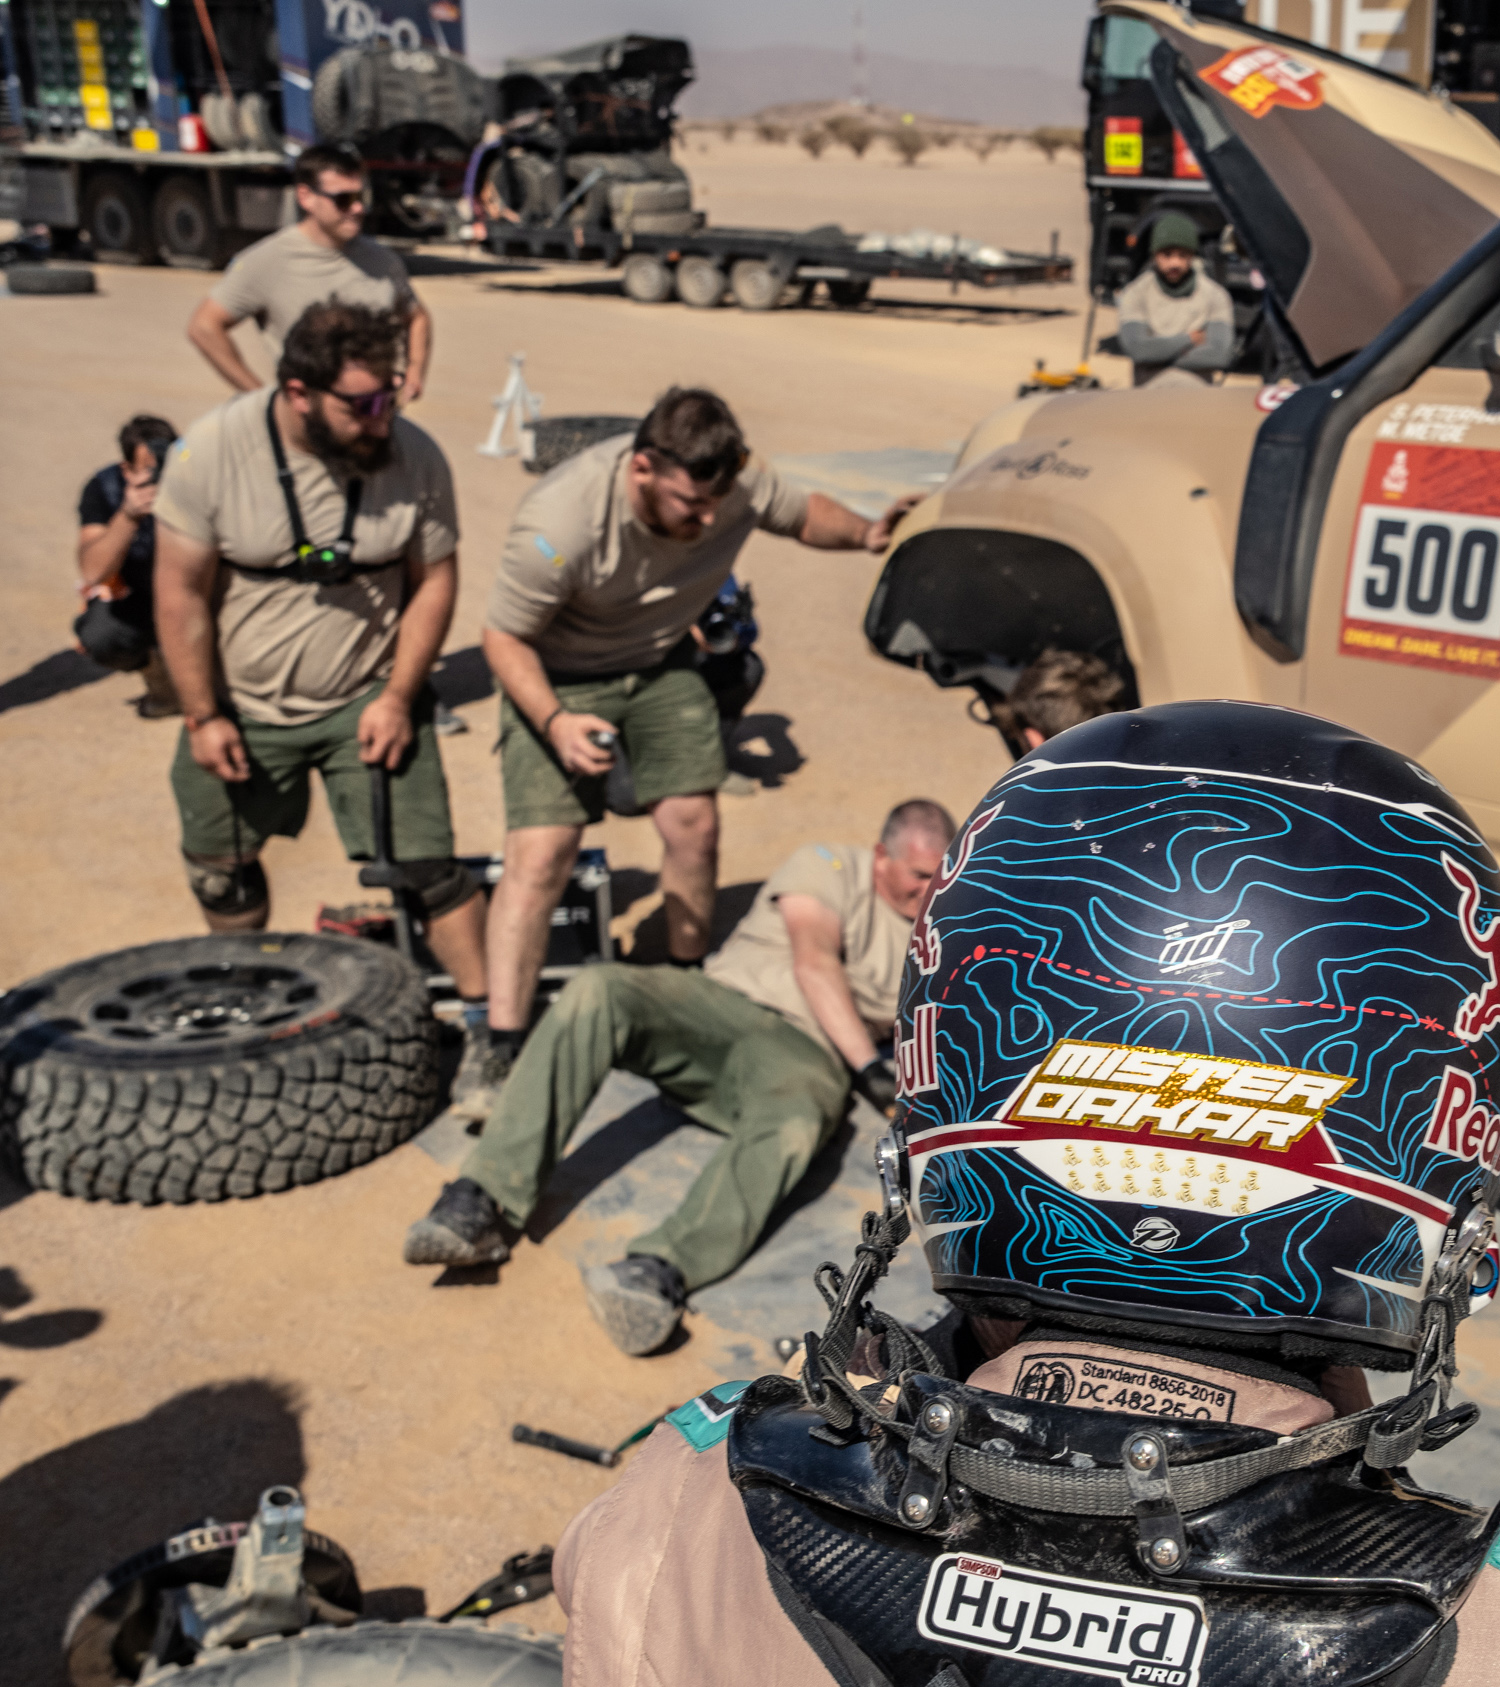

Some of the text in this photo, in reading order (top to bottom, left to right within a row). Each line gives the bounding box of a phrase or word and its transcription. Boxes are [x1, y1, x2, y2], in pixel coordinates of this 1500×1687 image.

[1363, 517, 1500, 623] 500
[1040, 1043, 1351, 1110] MISTER
[1016, 1081, 1316, 1148] DAKAR
[1080, 1361, 1226, 1408] Standard 8856-2018
[959, 1558, 999, 1578] SIMPSON
[945, 1573, 1176, 1661] Hybrid
[1130, 1665, 1188, 1685] PRO
